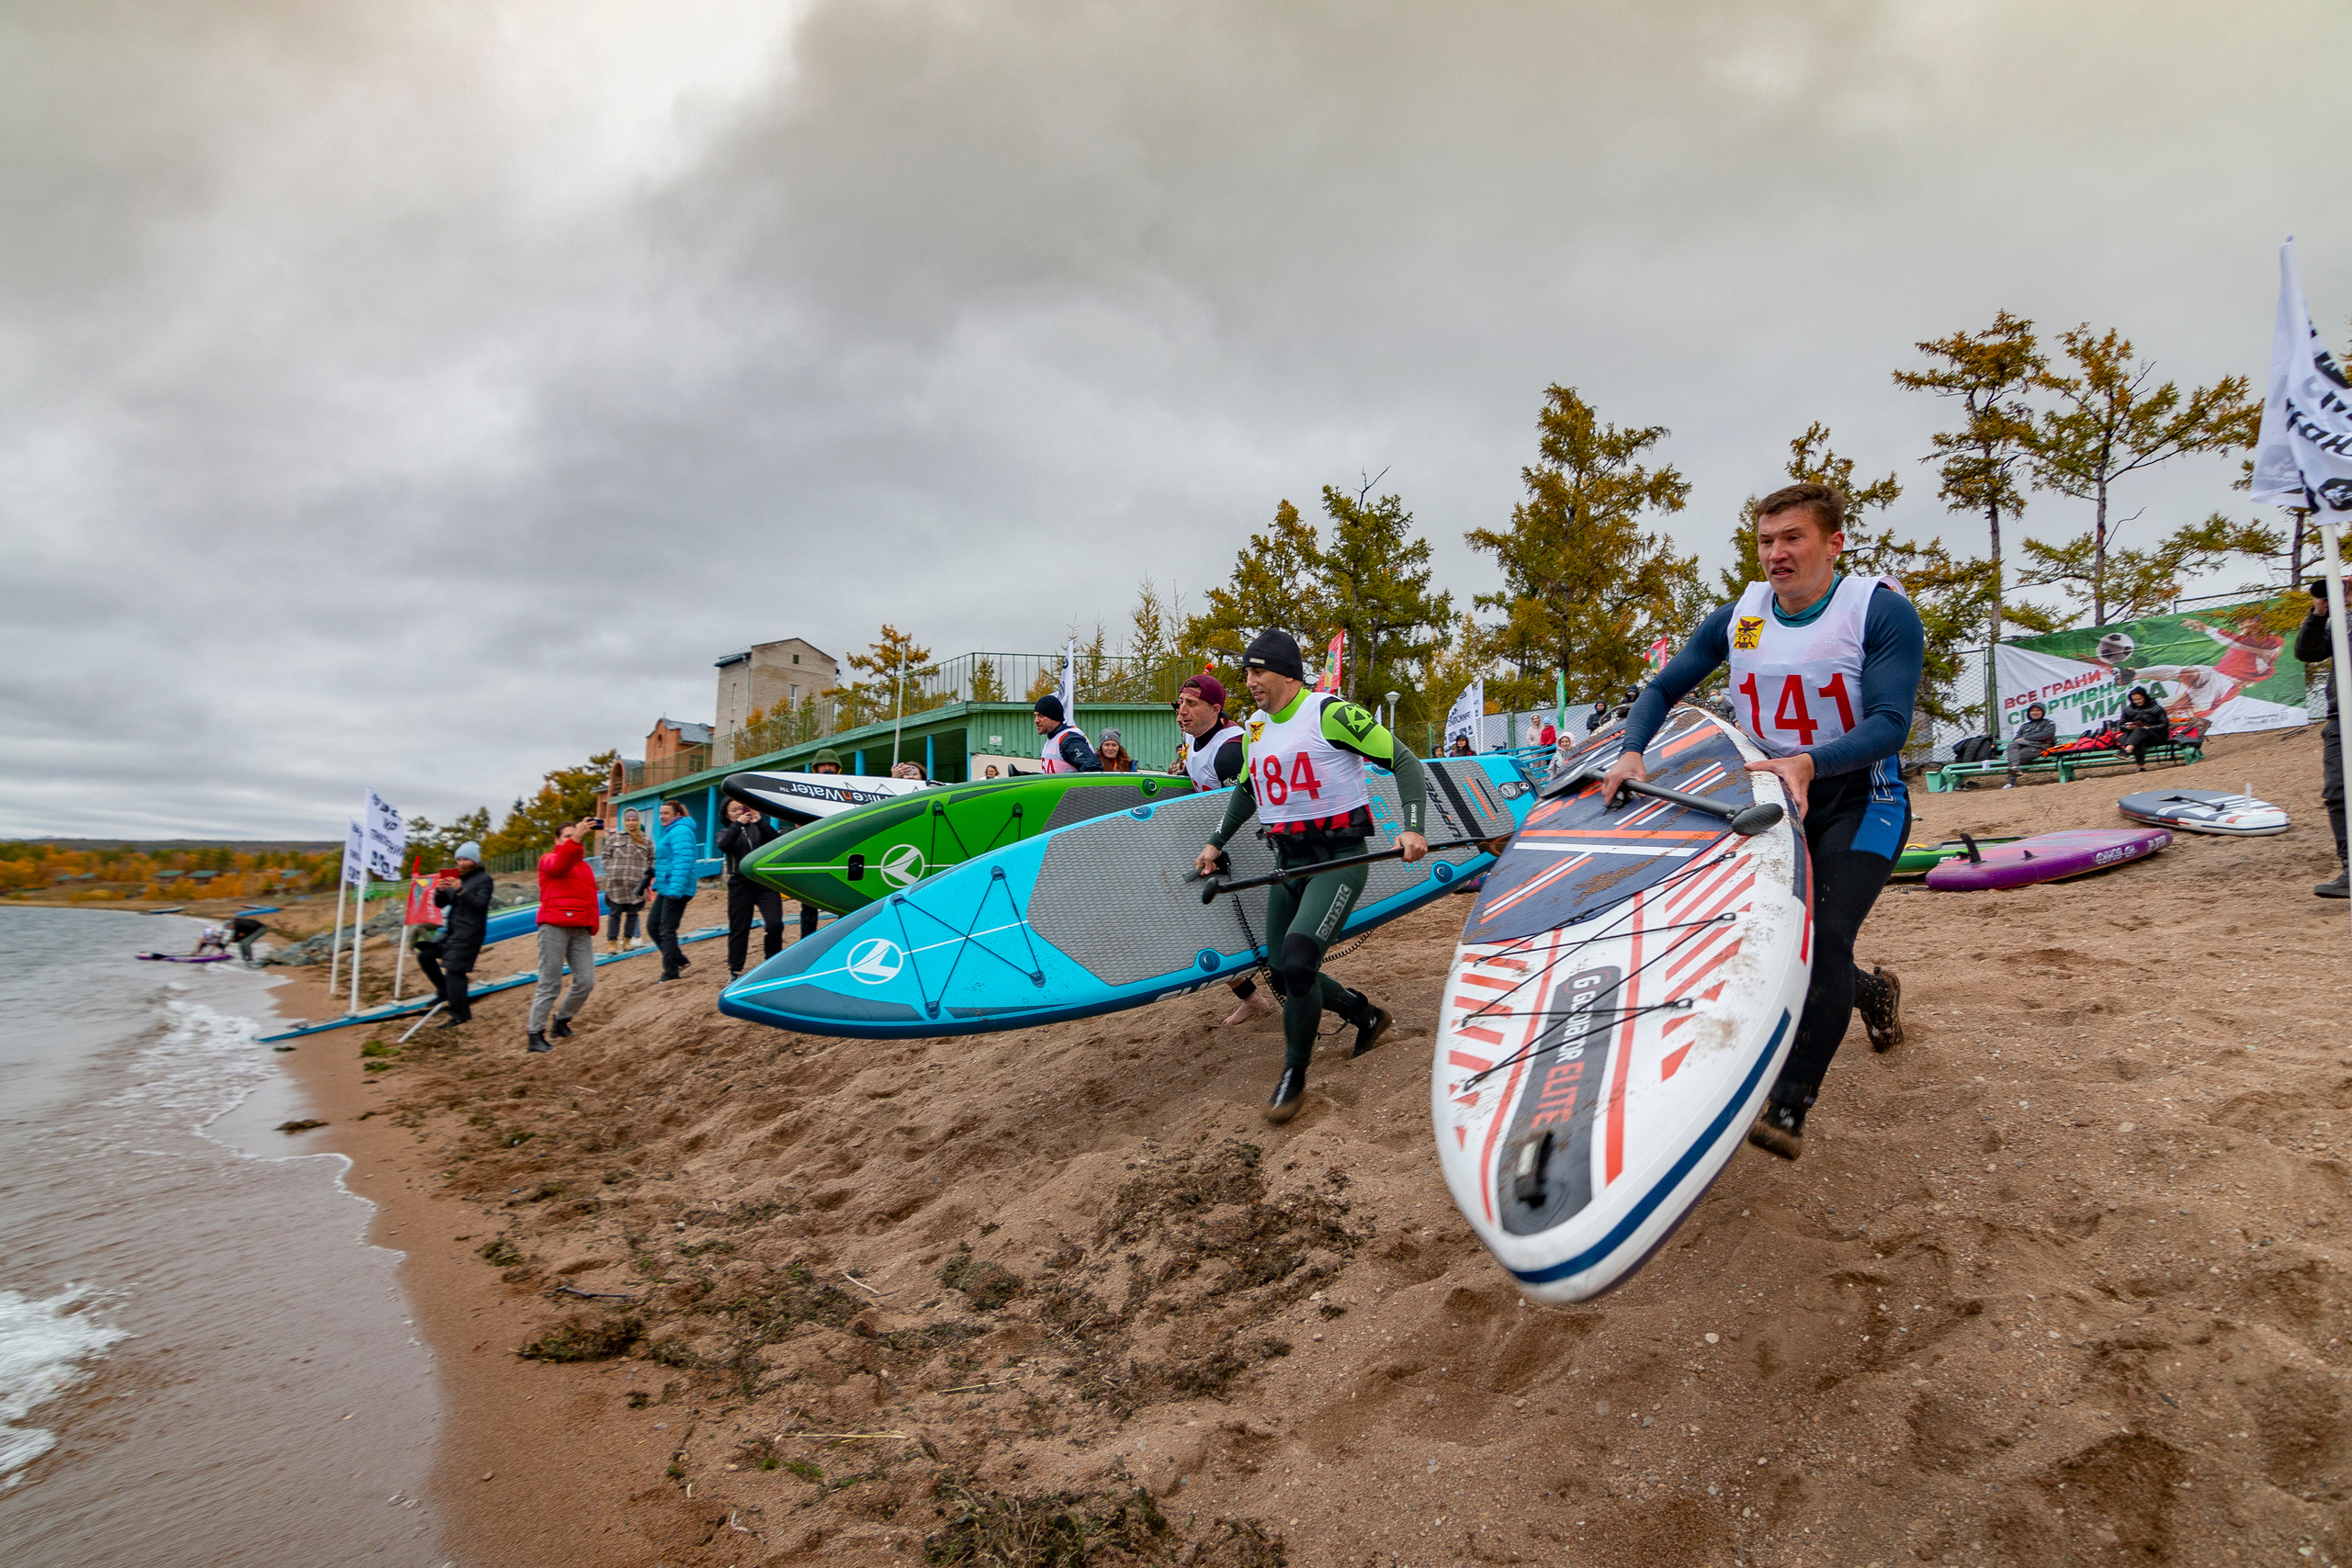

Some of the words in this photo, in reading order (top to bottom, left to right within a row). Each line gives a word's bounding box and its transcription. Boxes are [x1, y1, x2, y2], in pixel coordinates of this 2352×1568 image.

[1739, 672, 1856, 745] 141
[2004, 690, 2038, 710] ВСЕ
[2041, 669, 2101, 698] ГРАНИ
[2081, 681, 2168, 724] МИА
[1250, 751, 1321, 806] 184
[1324, 886, 1351, 931] MYSTIC
[1531, 1061, 1585, 1128] ELITE
